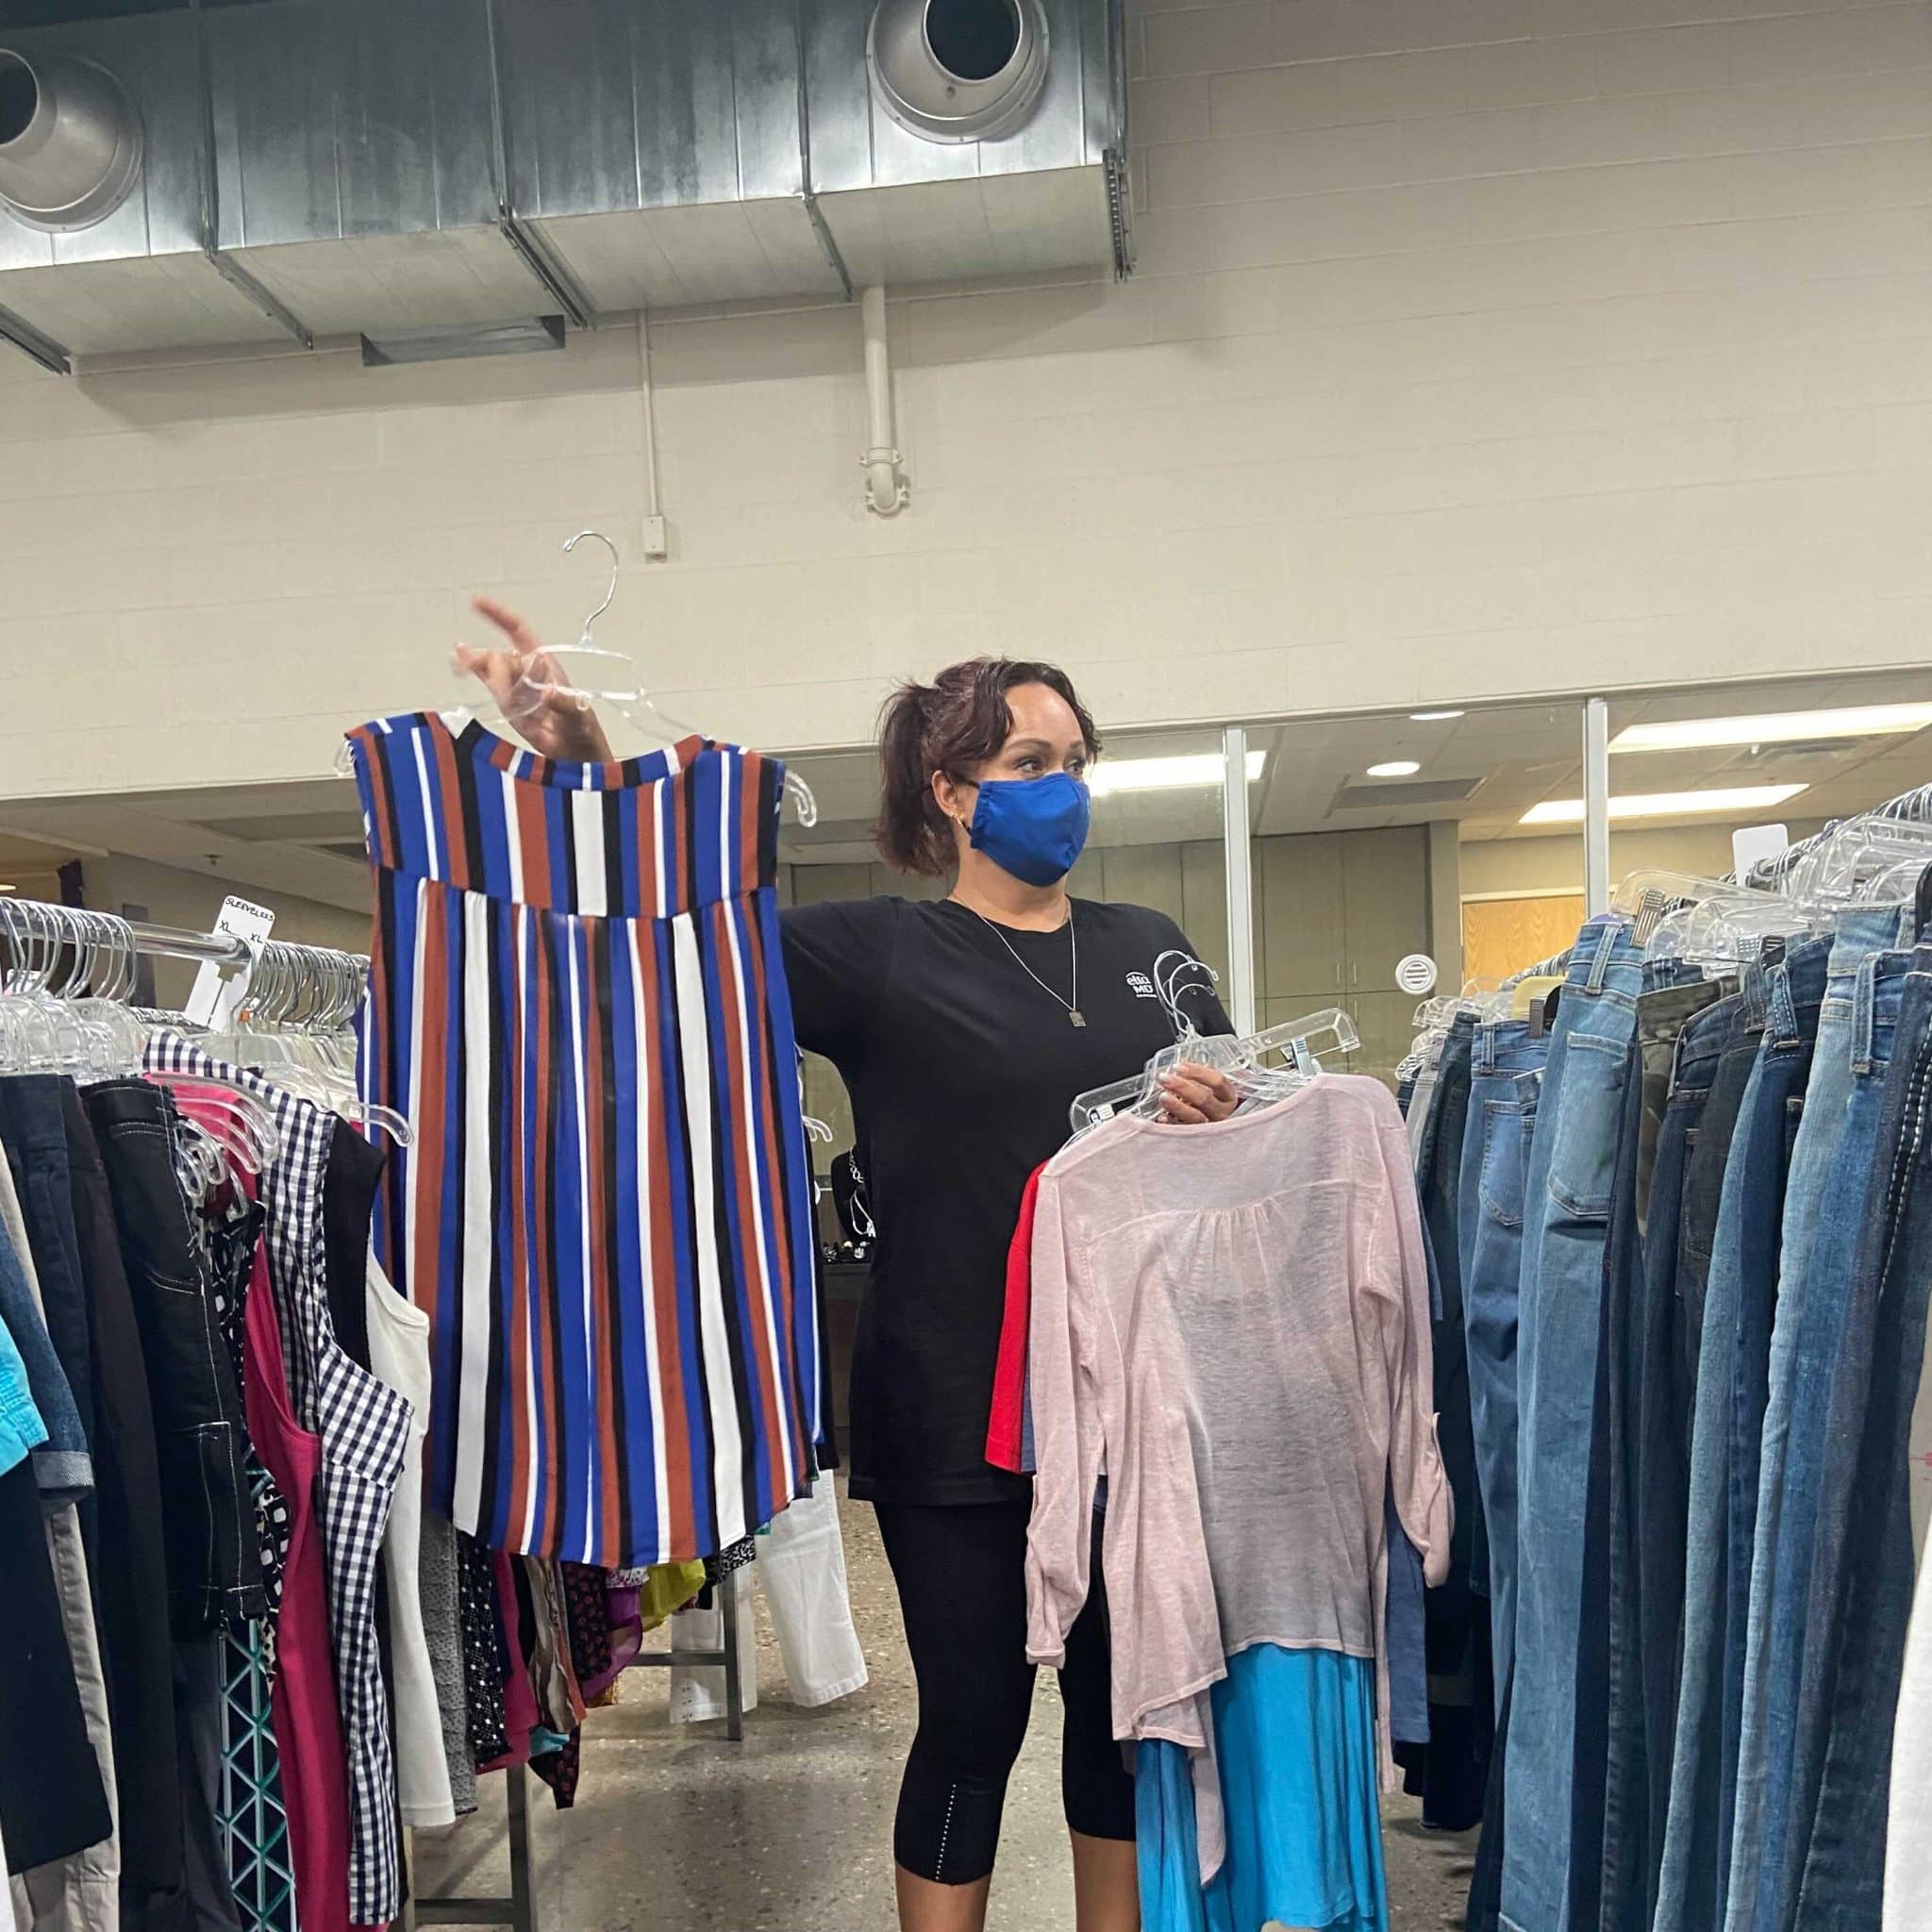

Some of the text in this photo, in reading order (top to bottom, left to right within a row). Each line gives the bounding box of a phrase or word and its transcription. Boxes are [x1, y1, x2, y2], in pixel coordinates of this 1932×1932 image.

[225, 897, 274, 922] SLEEVELESS
[219, 920, 263, 944] XL XL
[1132, 985, 1154, 993] MD
